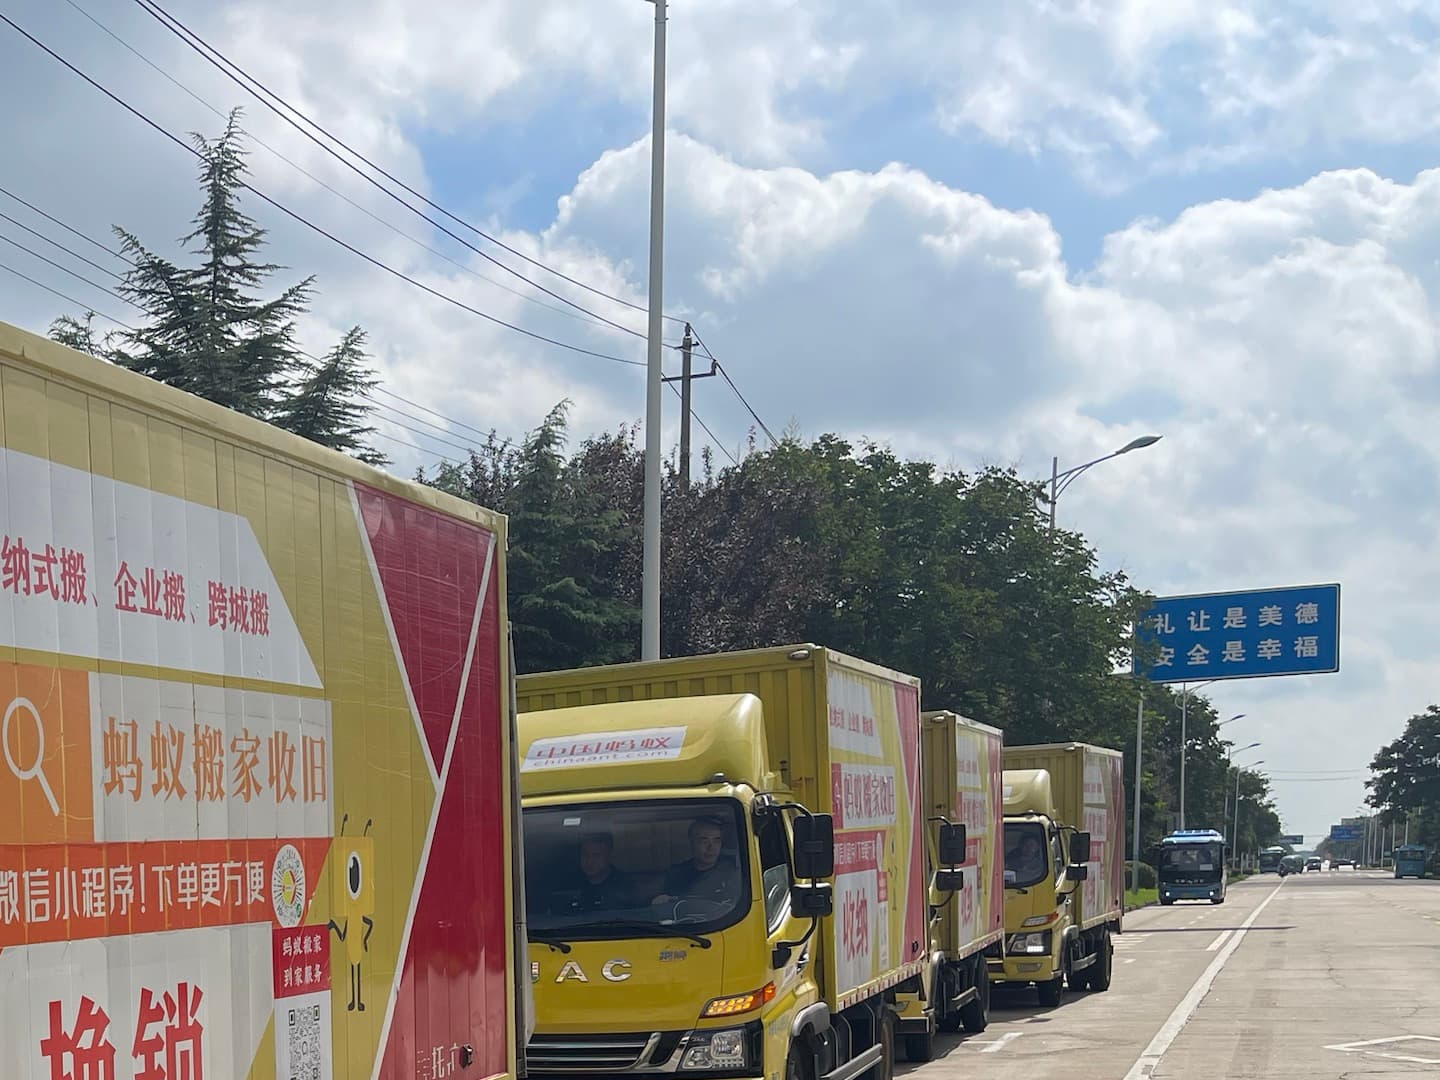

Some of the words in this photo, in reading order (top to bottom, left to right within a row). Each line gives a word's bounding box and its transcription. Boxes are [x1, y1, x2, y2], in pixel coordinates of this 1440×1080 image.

[1154, 602, 1319, 634] 礼让是美德
[1154, 636, 1319, 666] 安全是幸福
[103, 716, 327, 804] 蚂蚁搬家收旧
[842, 887, 869, 962] 收纳
